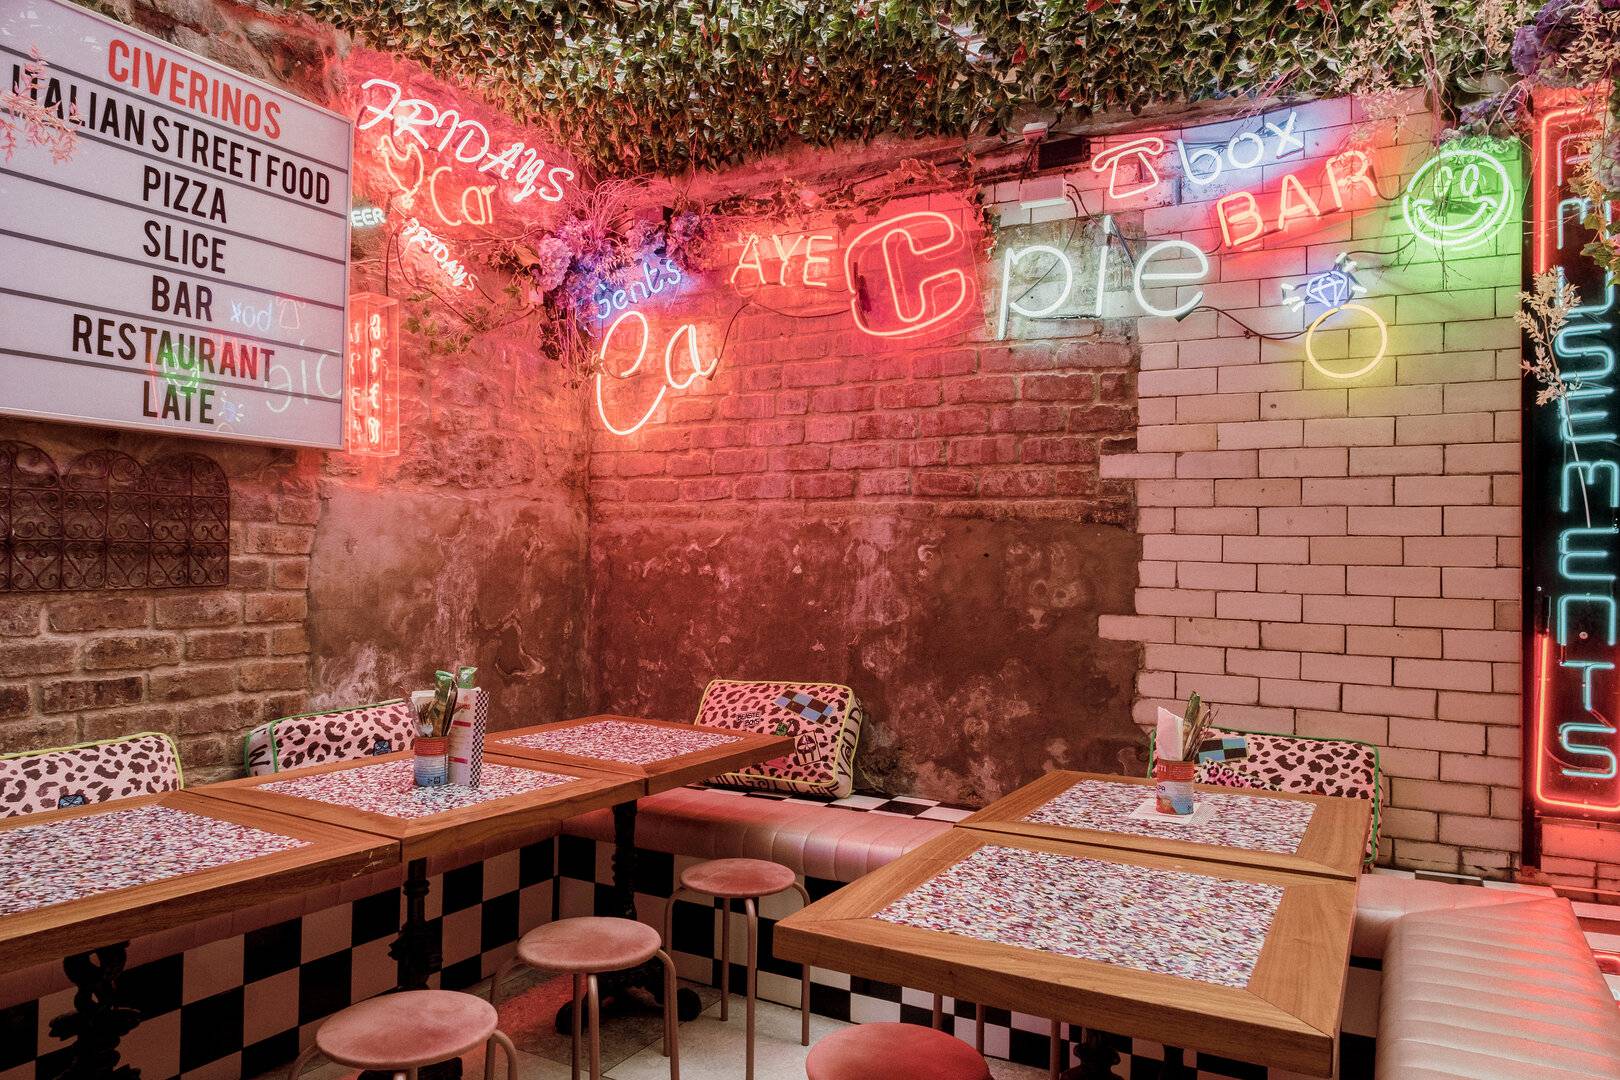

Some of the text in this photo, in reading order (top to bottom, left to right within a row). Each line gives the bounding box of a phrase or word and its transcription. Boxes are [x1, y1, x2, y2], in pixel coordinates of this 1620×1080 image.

[108, 39, 281, 139] CIVERINOS
[12, 64, 329, 205] ITALIAN STREET FOOD
[359, 78, 574, 202] FRIDAYS
[1179, 111, 1304, 184] box
[143, 165, 227, 223] PIZZA
[351, 207, 386, 227] EER
[1216, 151, 1377, 248] BAR
[143, 220, 226, 274] SLICE
[730, 235, 834, 287] AYE
[997, 218, 1209, 341] pie
[152, 275, 213, 321] BAR
[72, 313, 275, 382] RESTAURANT
[143, 381, 215, 424] LATE
